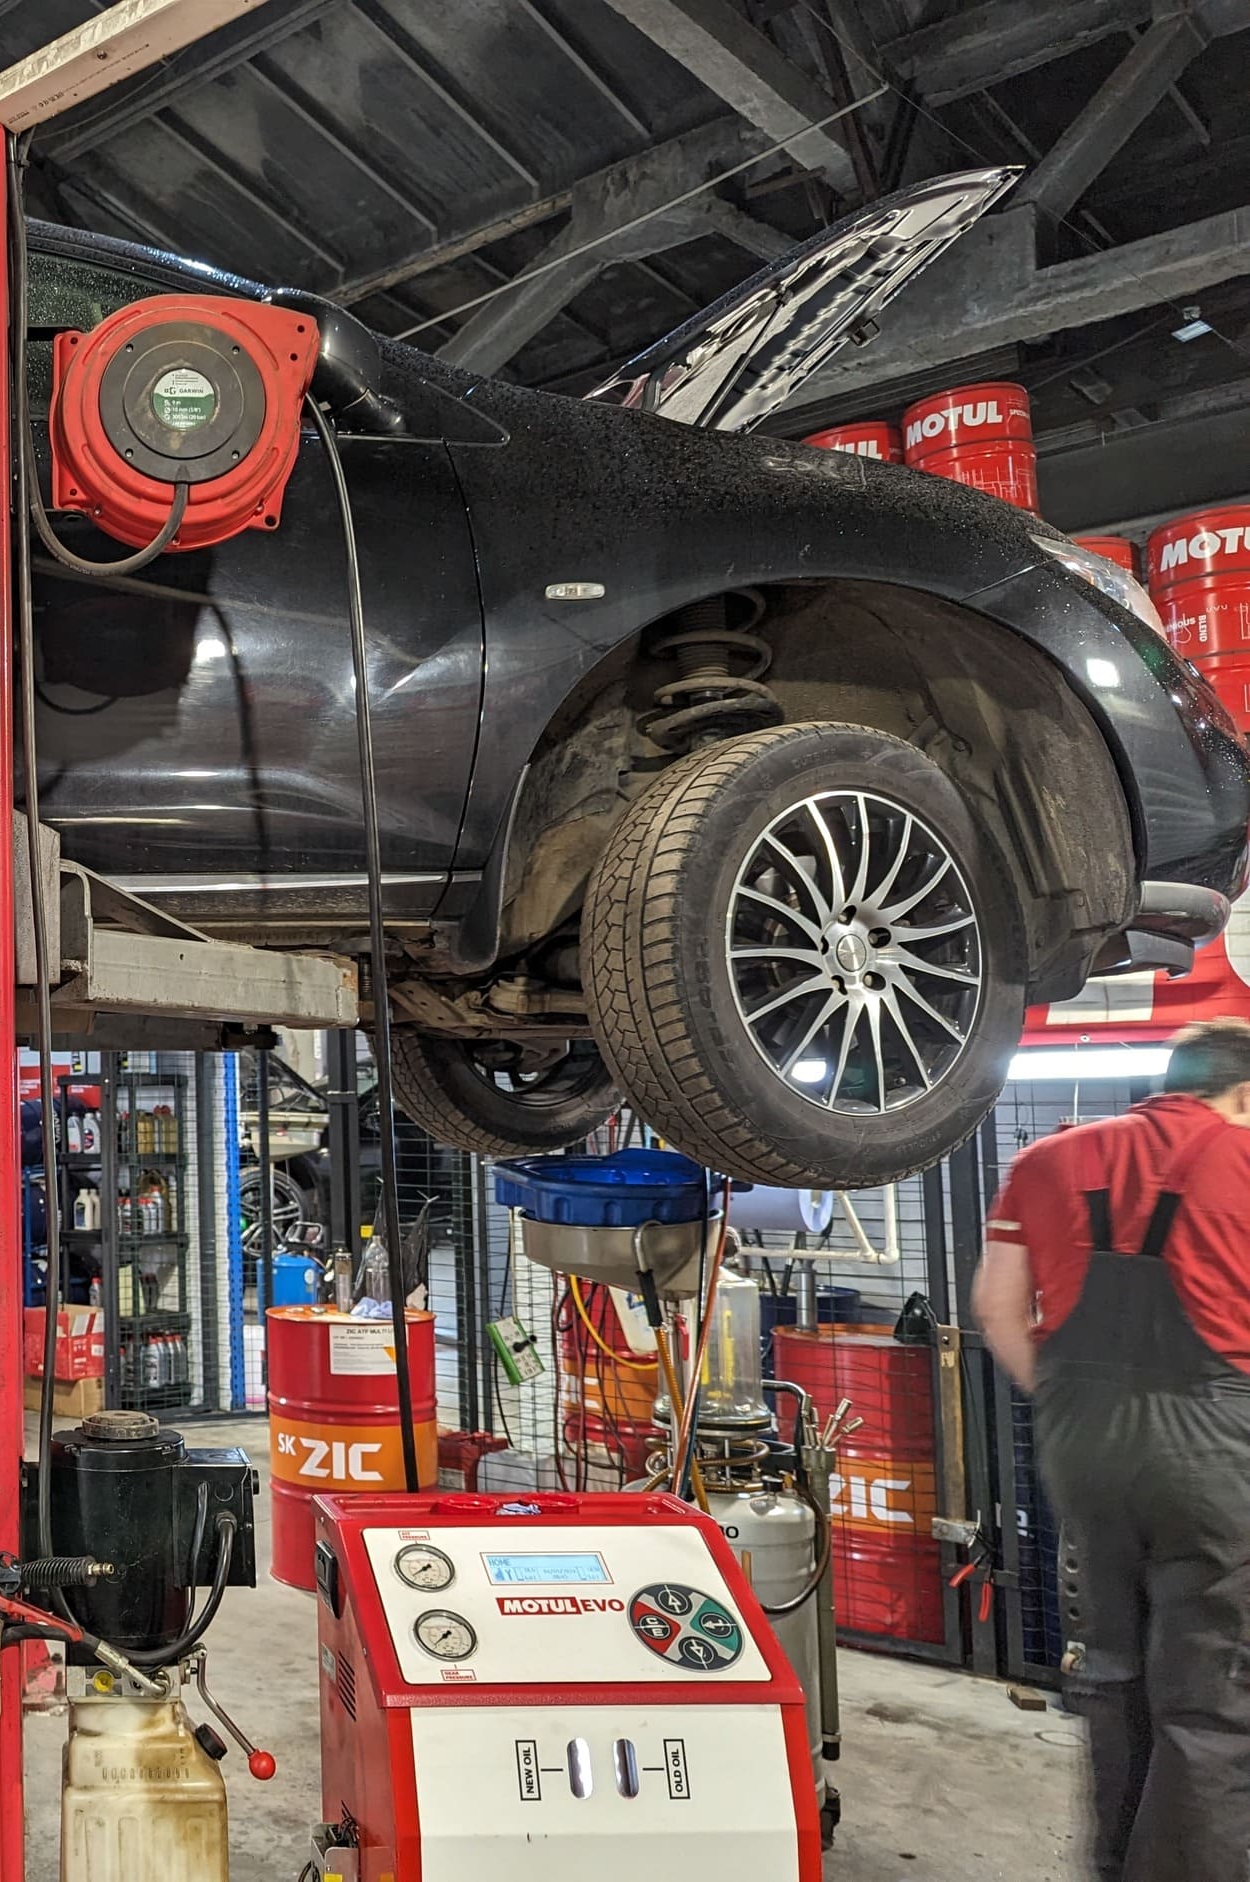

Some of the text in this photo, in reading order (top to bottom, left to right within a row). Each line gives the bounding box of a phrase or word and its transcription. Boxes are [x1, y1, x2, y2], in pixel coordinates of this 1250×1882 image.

[906, 400, 1003, 450] MOTUL
[1198, 614, 1208, 642] BLEND
[277, 1432, 385, 1481] SK ZIC
[488, 1558, 510, 1567] HOME
[503, 1599, 626, 1614] MOTUL EVO
[521, 1746, 535, 1794] NEW OIL
[670, 1747, 684, 1793] OLD OIL
